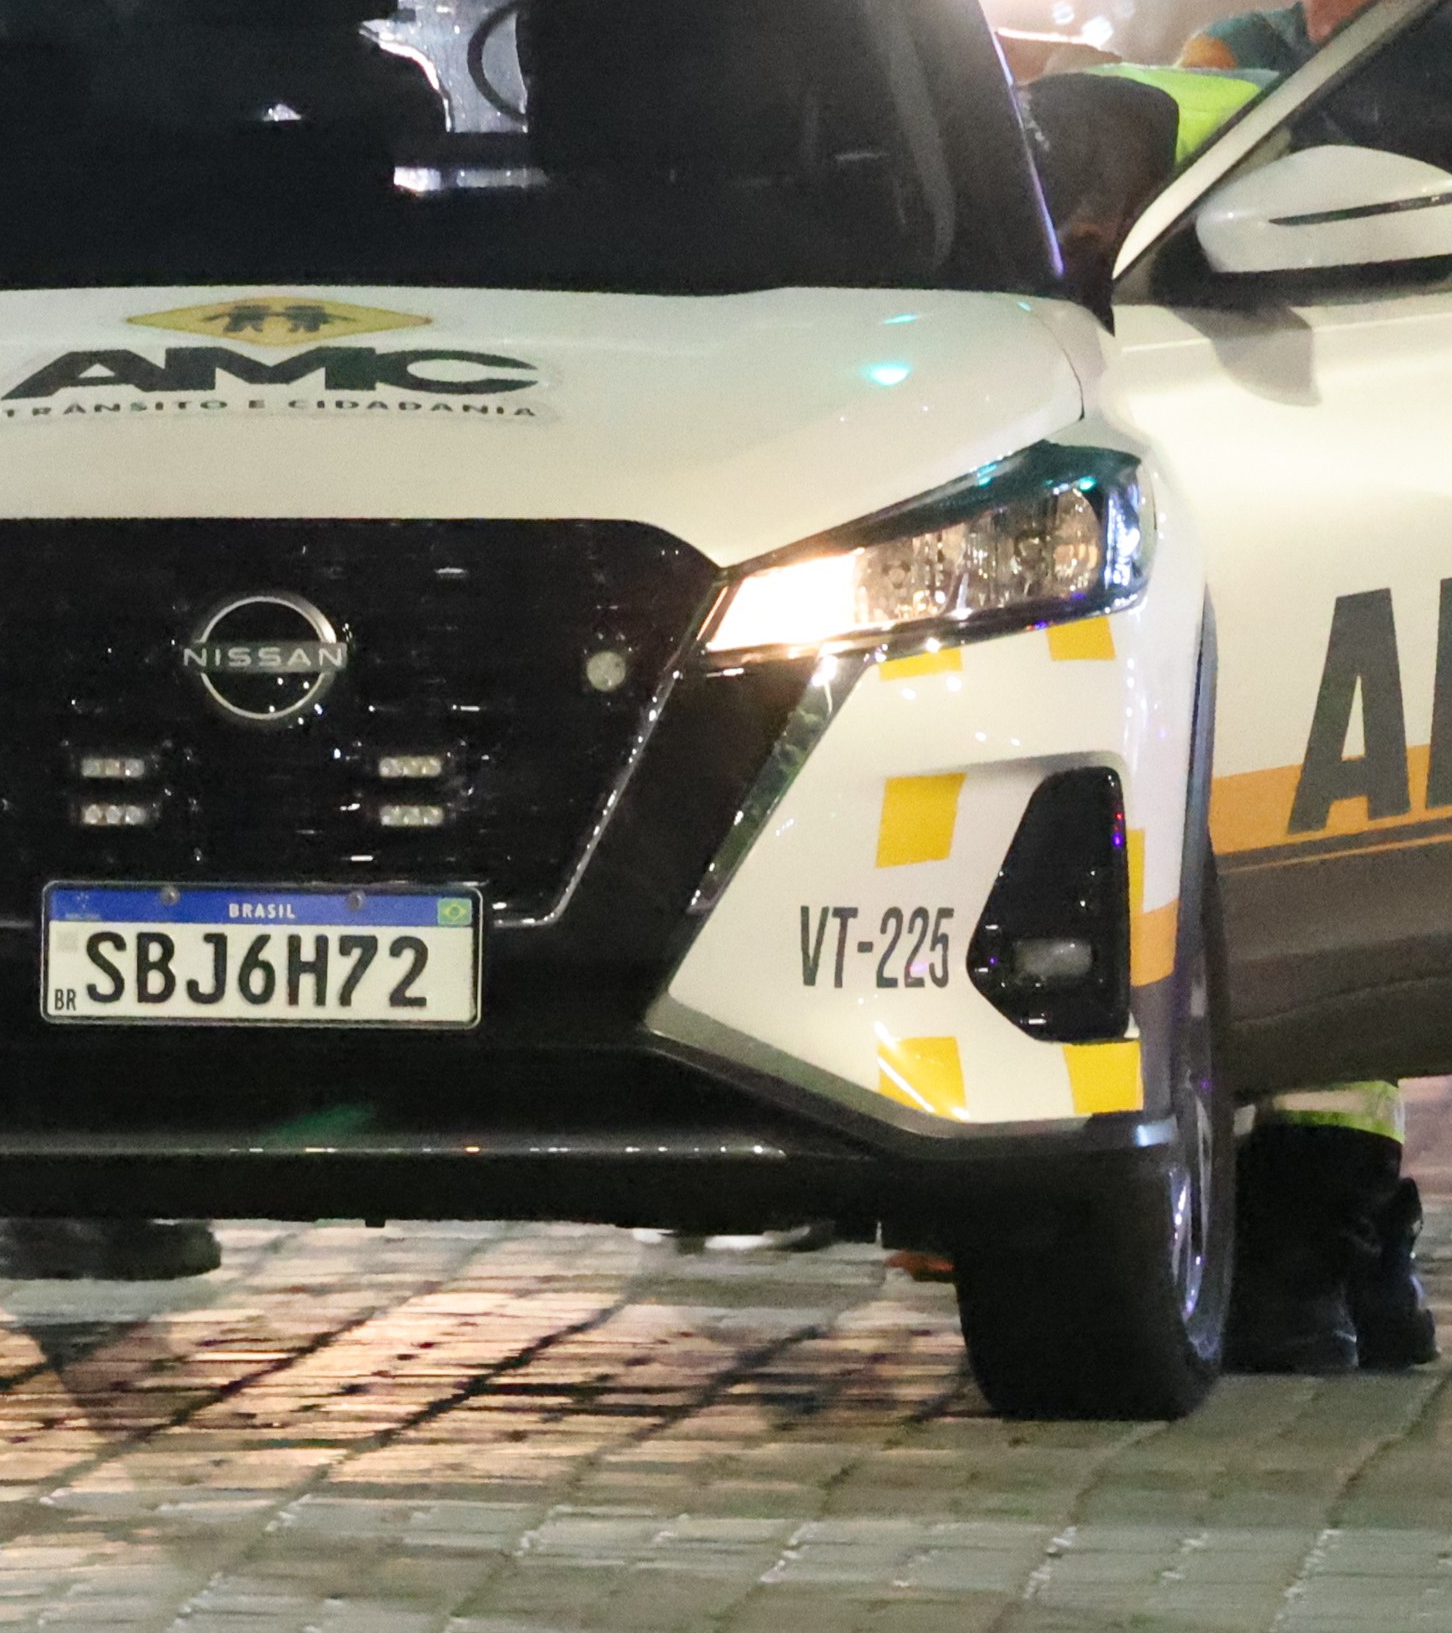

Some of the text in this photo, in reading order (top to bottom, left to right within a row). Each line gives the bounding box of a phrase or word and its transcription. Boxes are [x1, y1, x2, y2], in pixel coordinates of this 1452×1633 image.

[0, 345, 540, 401] AMC
[247, 399, 266, 410] E
[287, 399, 536, 417] CIDADANIA
[183, 646, 343, 667] NISSAN
[227, 902, 296, 919] BRASIL
[799, 905, 954, 989] VT-225
[53, 931, 429, 1012] BR SBJ6H72
